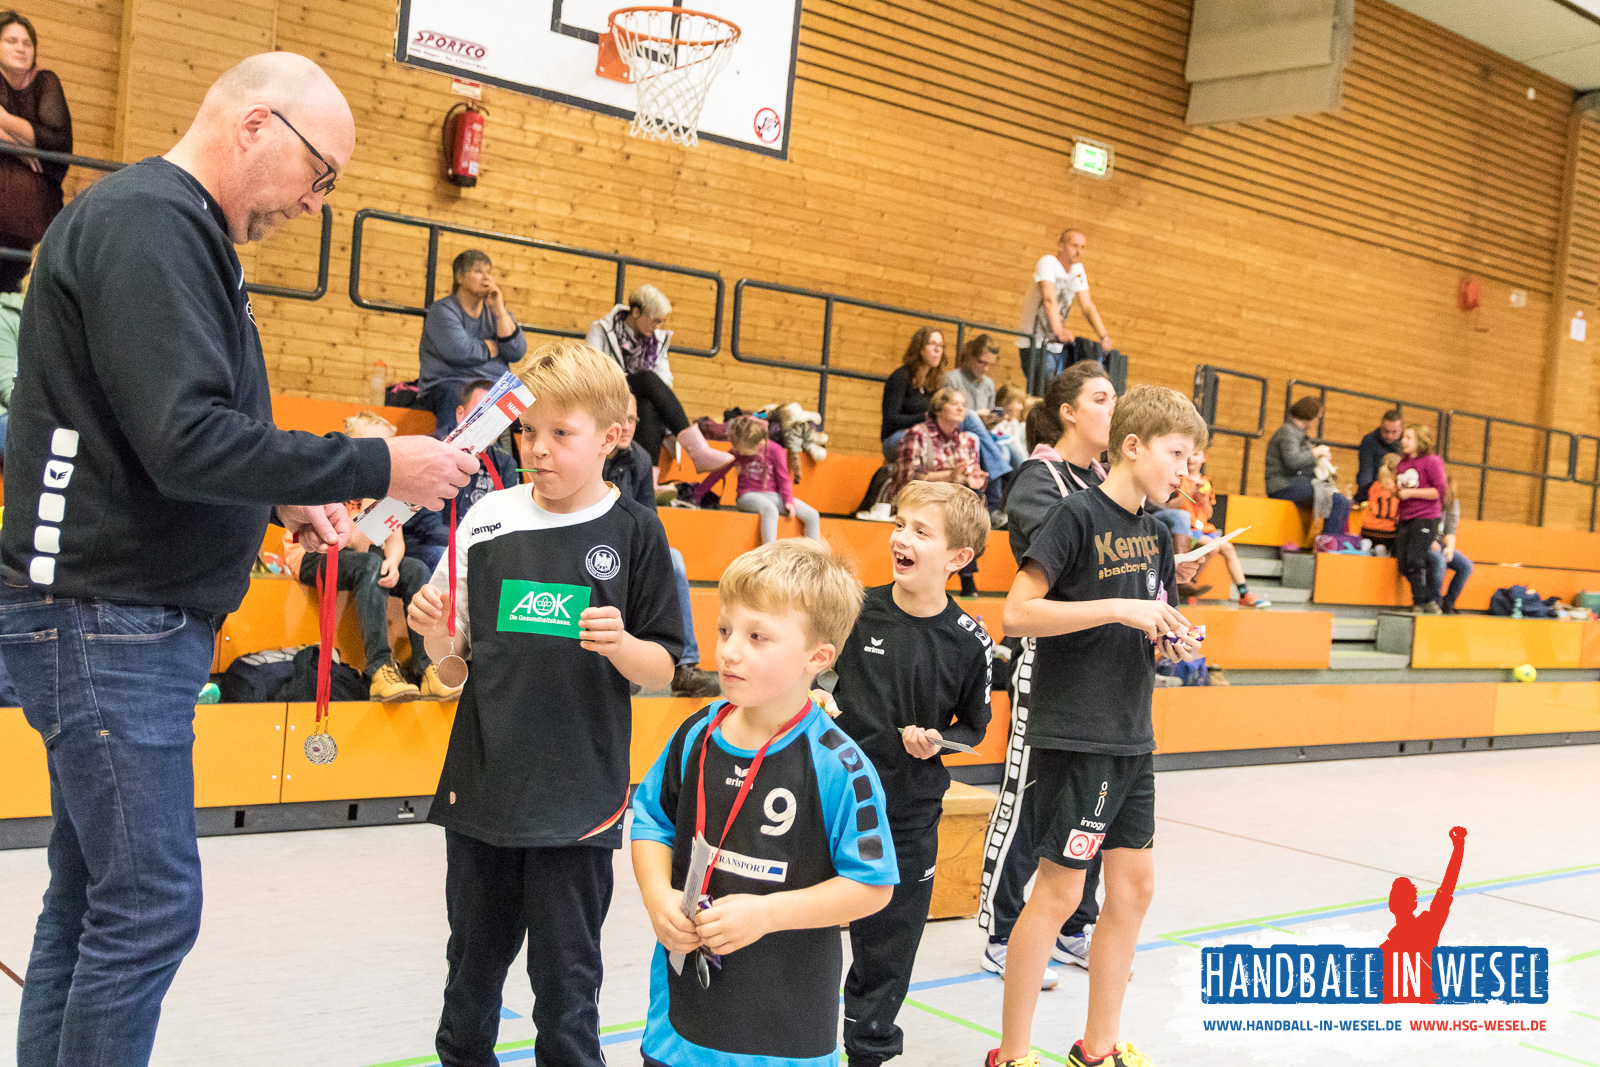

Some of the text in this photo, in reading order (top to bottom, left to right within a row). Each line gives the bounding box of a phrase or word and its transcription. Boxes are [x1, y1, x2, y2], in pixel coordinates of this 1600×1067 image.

[415, 31, 486, 58] SPORTCO
[1094, 531, 1160, 565] Kemp
[1098, 562, 1147, 580] #badboys
[511, 591, 574, 619] AOK
[518, 614, 572, 626] Gesundheitskasse.
[760, 788, 797, 836] 9
[1080, 816, 1106, 831] innogy
